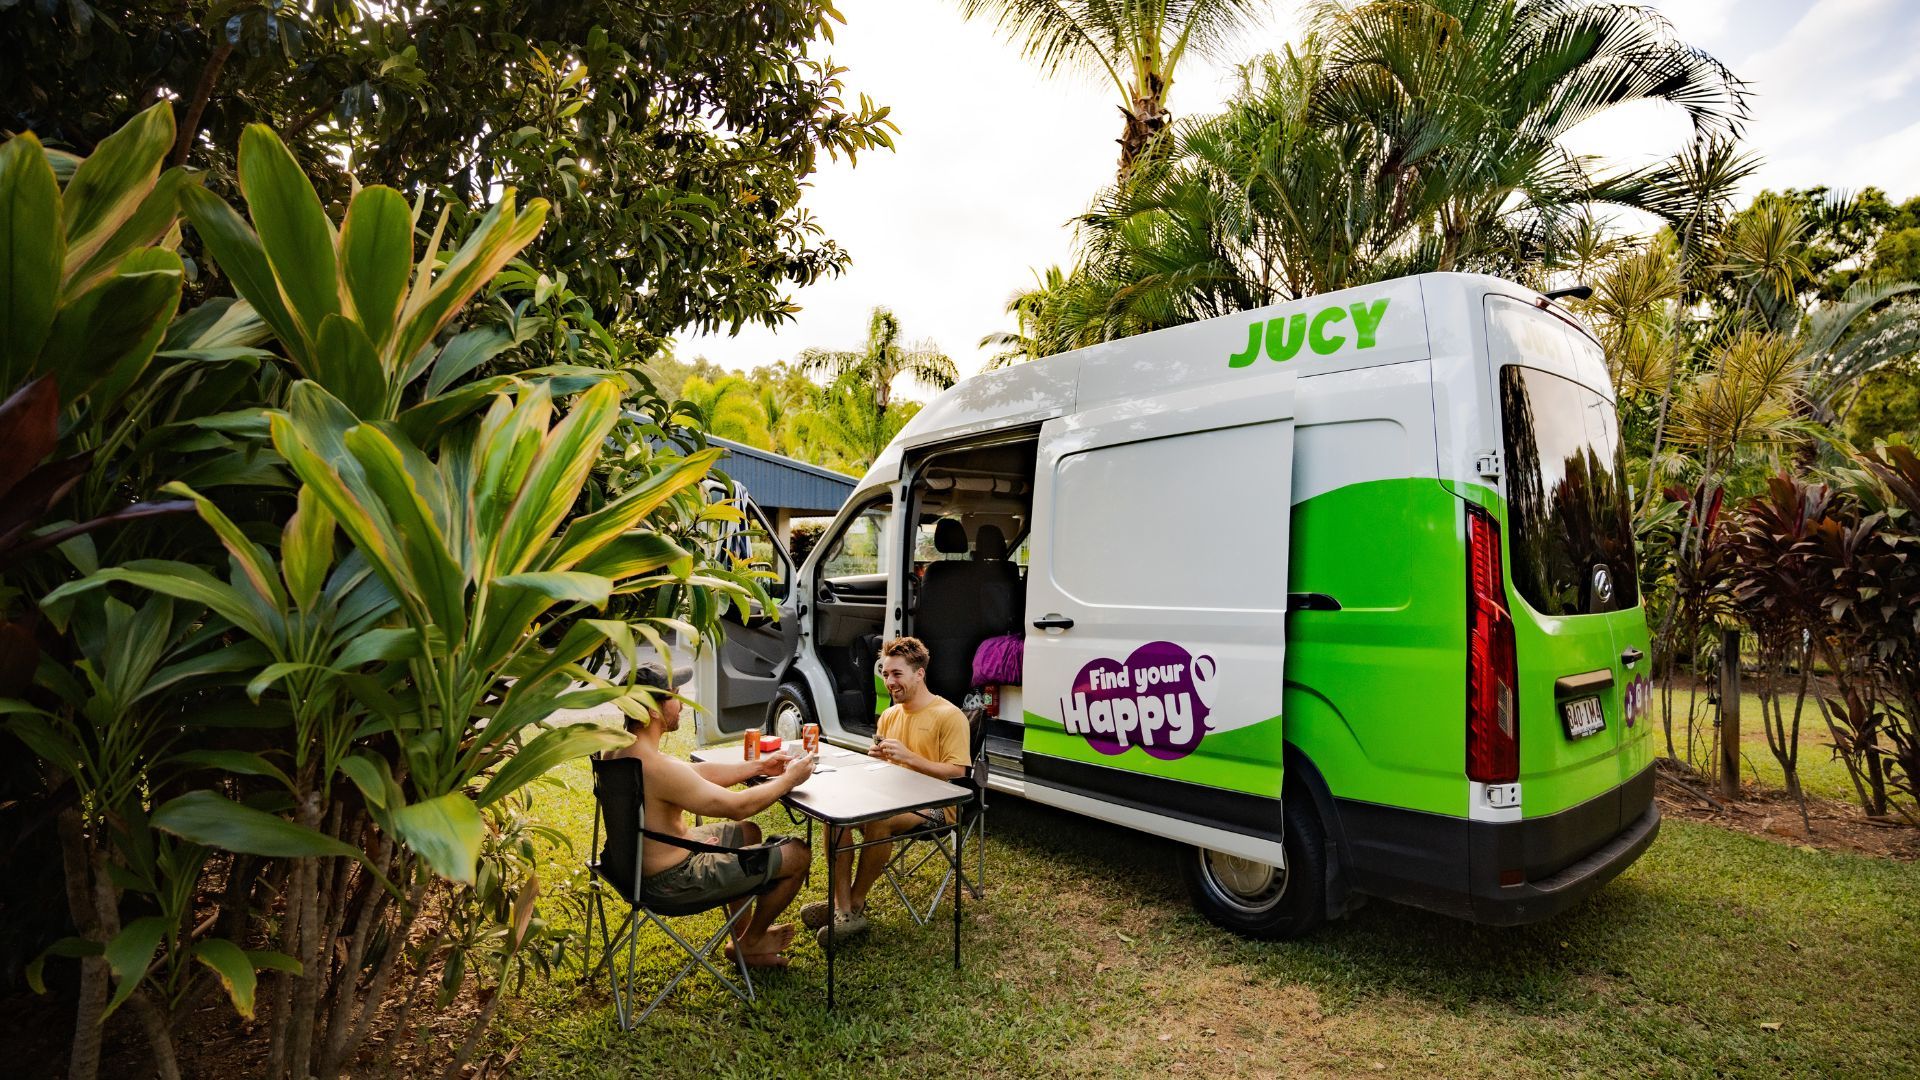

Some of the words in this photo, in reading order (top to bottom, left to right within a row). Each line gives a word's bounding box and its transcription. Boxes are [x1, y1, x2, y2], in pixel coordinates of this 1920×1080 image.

[1228, 297, 1391, 369] JUCY
[1089, 666, 1130, 691] Find
[1134, 663, 1184, 693] your
[1060, 691, 1194, 747] Happy
